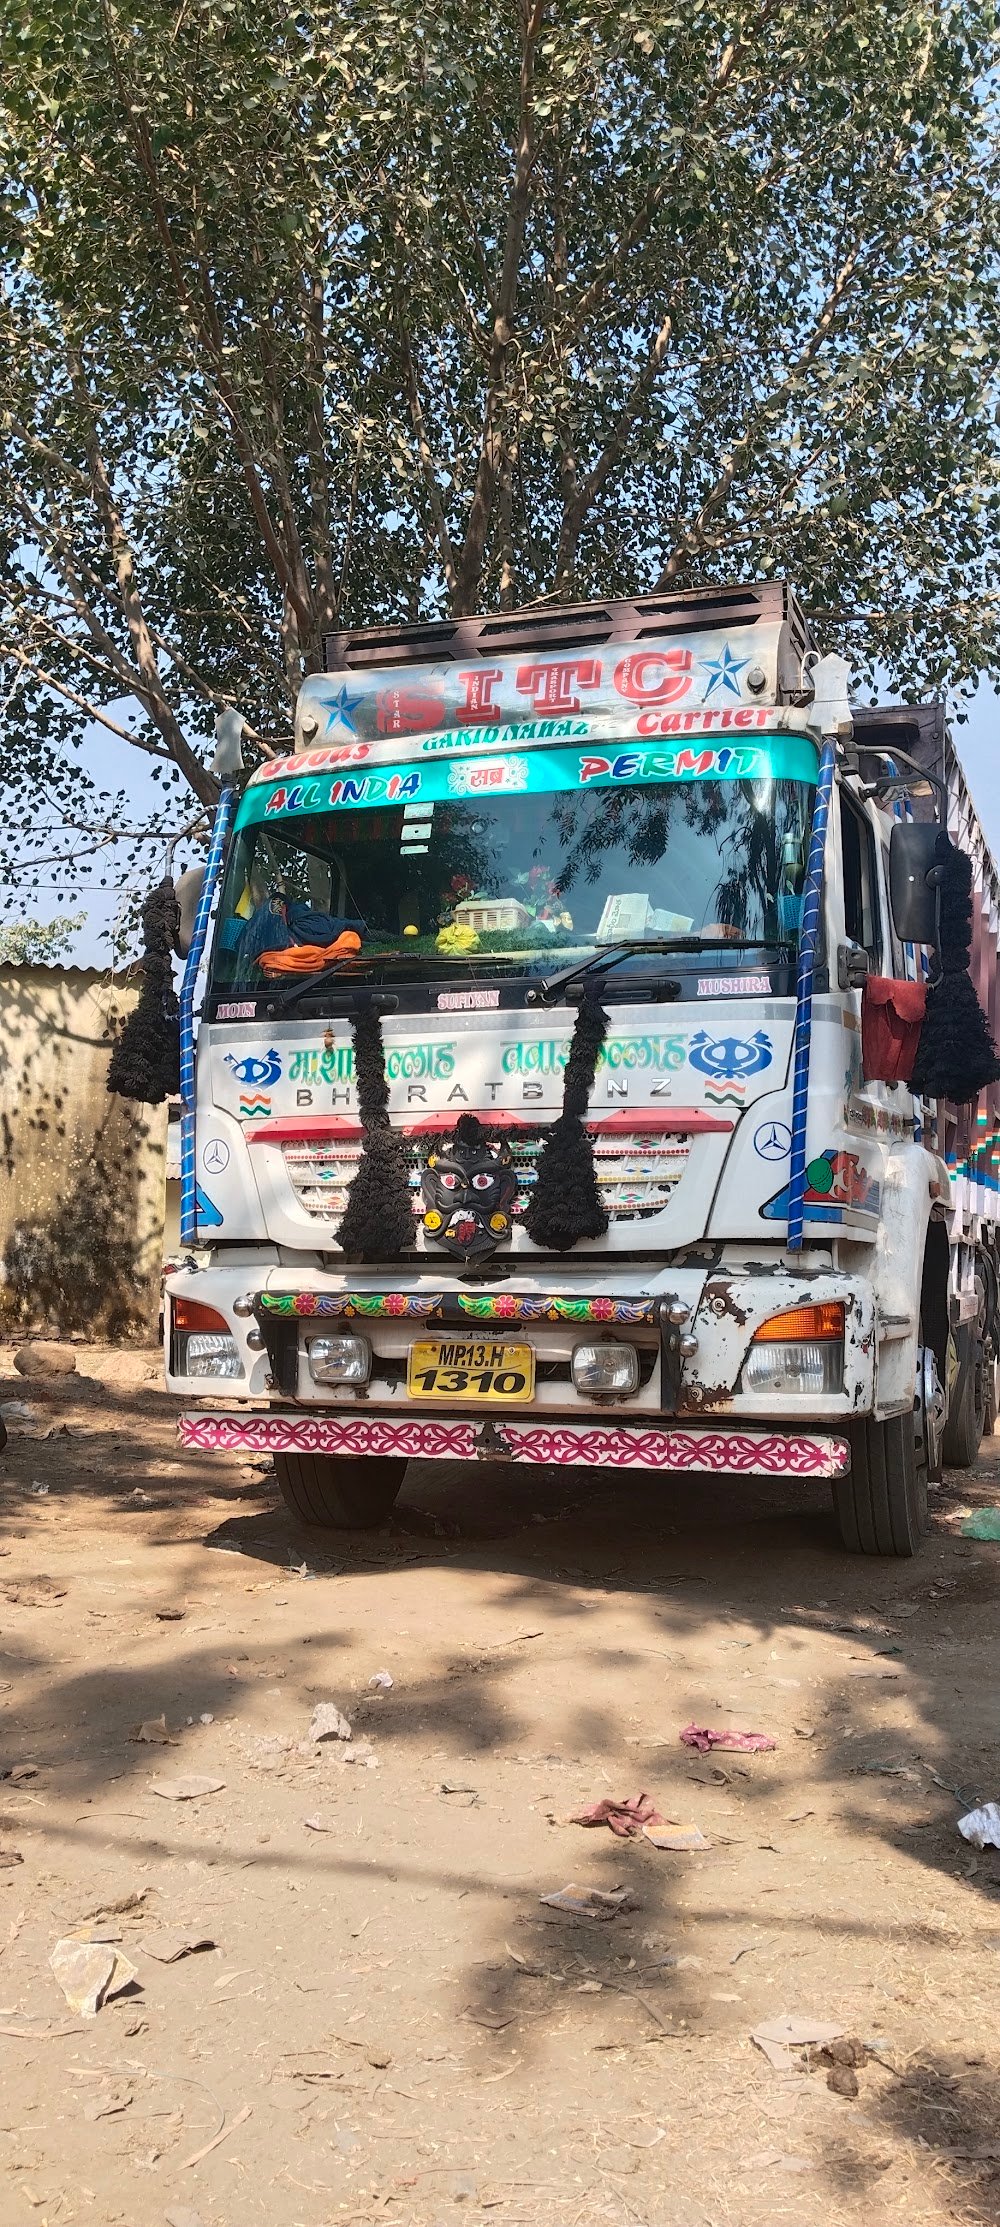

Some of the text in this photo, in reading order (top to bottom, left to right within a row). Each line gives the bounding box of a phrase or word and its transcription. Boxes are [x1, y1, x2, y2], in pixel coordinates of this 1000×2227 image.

[621, 658, 632, 693] COMPANY
[470, 675, 479, 711] INDIAN
[393, 691, 401, 729] STAR
[637, 707, 775, 735] Carrier
[579, 747, 762, 783] PERMIT
[265, 772, 421, 816] ALL INDIA
[437, 990, 500, 1011] SUFIYAN
[697, 976, 772, 996] MUSHIRA
[216, 1001, 257, 1019] MOIN
[296, 1078, 672, 1107] BHRATBNZ
[414, 1369, 526, 1394] 1310
